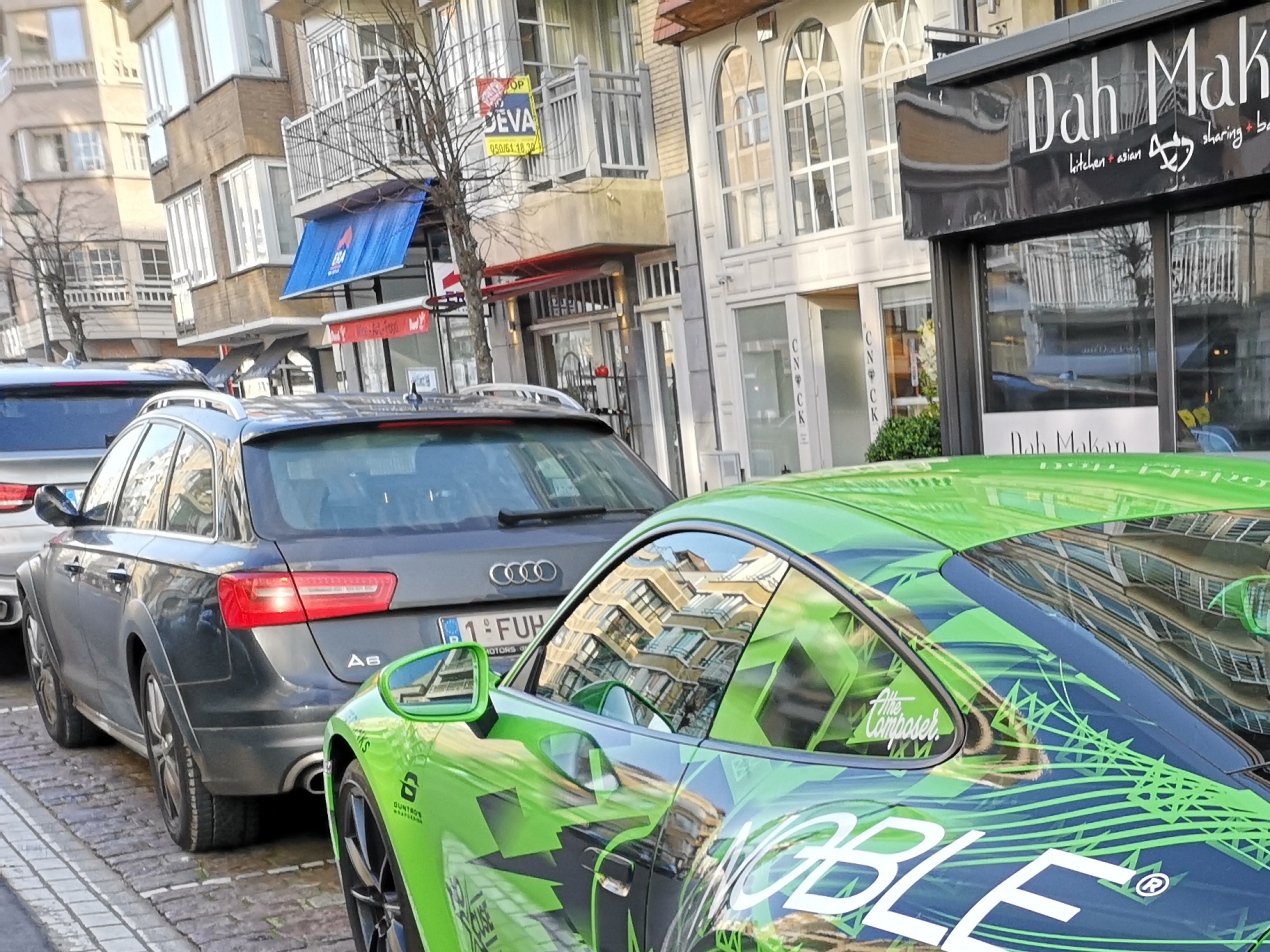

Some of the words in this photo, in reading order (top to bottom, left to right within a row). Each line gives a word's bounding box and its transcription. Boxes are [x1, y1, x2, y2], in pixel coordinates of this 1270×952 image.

[1027, 56, 1118, 154] Dah
[1069, 152, 1106, 174] kitchen
[1117, 149, 1142, 164] asian
[1203, 121, 1243, 149] sharing
[347, 653, 381, 668] A6
